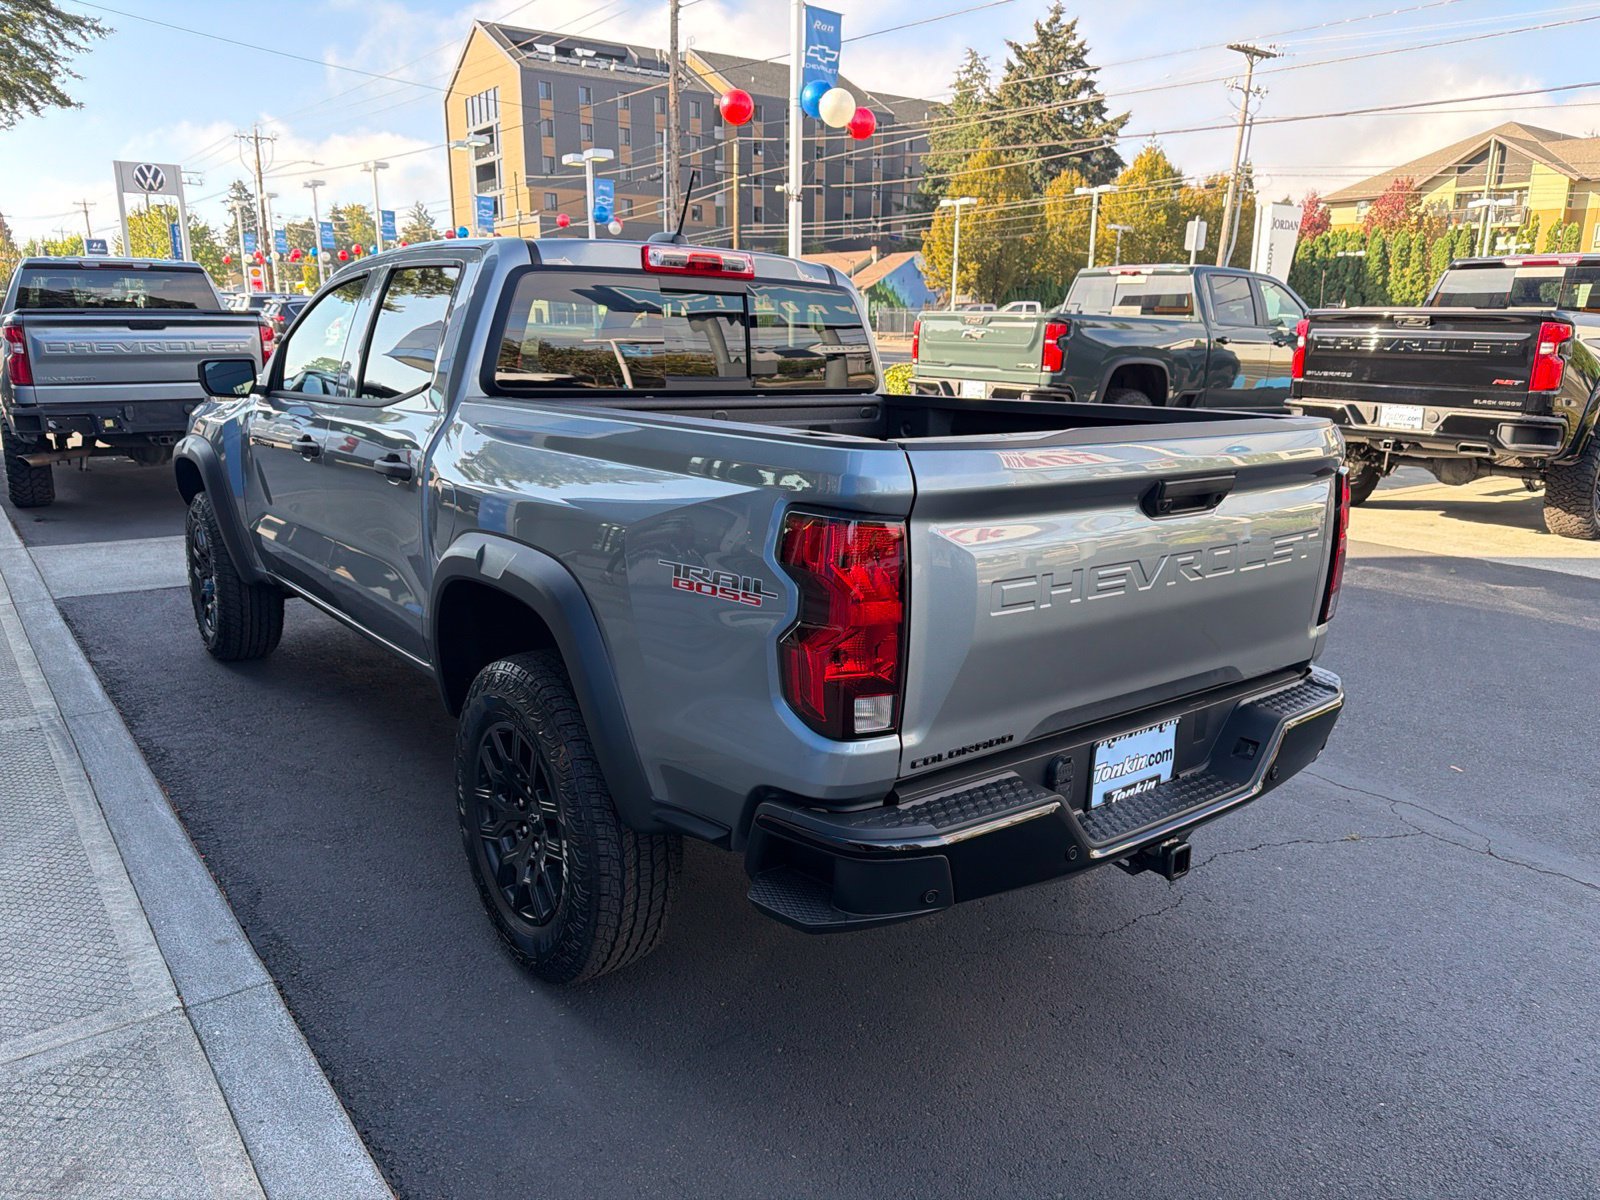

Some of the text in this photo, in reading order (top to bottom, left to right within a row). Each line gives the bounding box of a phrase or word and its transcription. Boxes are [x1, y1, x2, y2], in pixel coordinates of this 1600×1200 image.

[814, 20, 834, 32] Ran
[1271, 217, 1299, 230] JORDAN
[44, 341, 248, 354] CHEVROLET
[1315, 338, 1520, 354] CHEVROLET
[1306, 369, 1353, 378] SILVERADO
[1473, 398, 1497, 406] BLACK
[658, 559, 778, 599] TRAIL
[990, 528, 1320, 616] CHEVROLET
[672, 576, 762, 607] BOSS
[910, 733, 1015, 769] COLORADO
[1093, 747, 1174, 784] Tonkin.com
[1111, 780, 1158, 803] Tonkin
